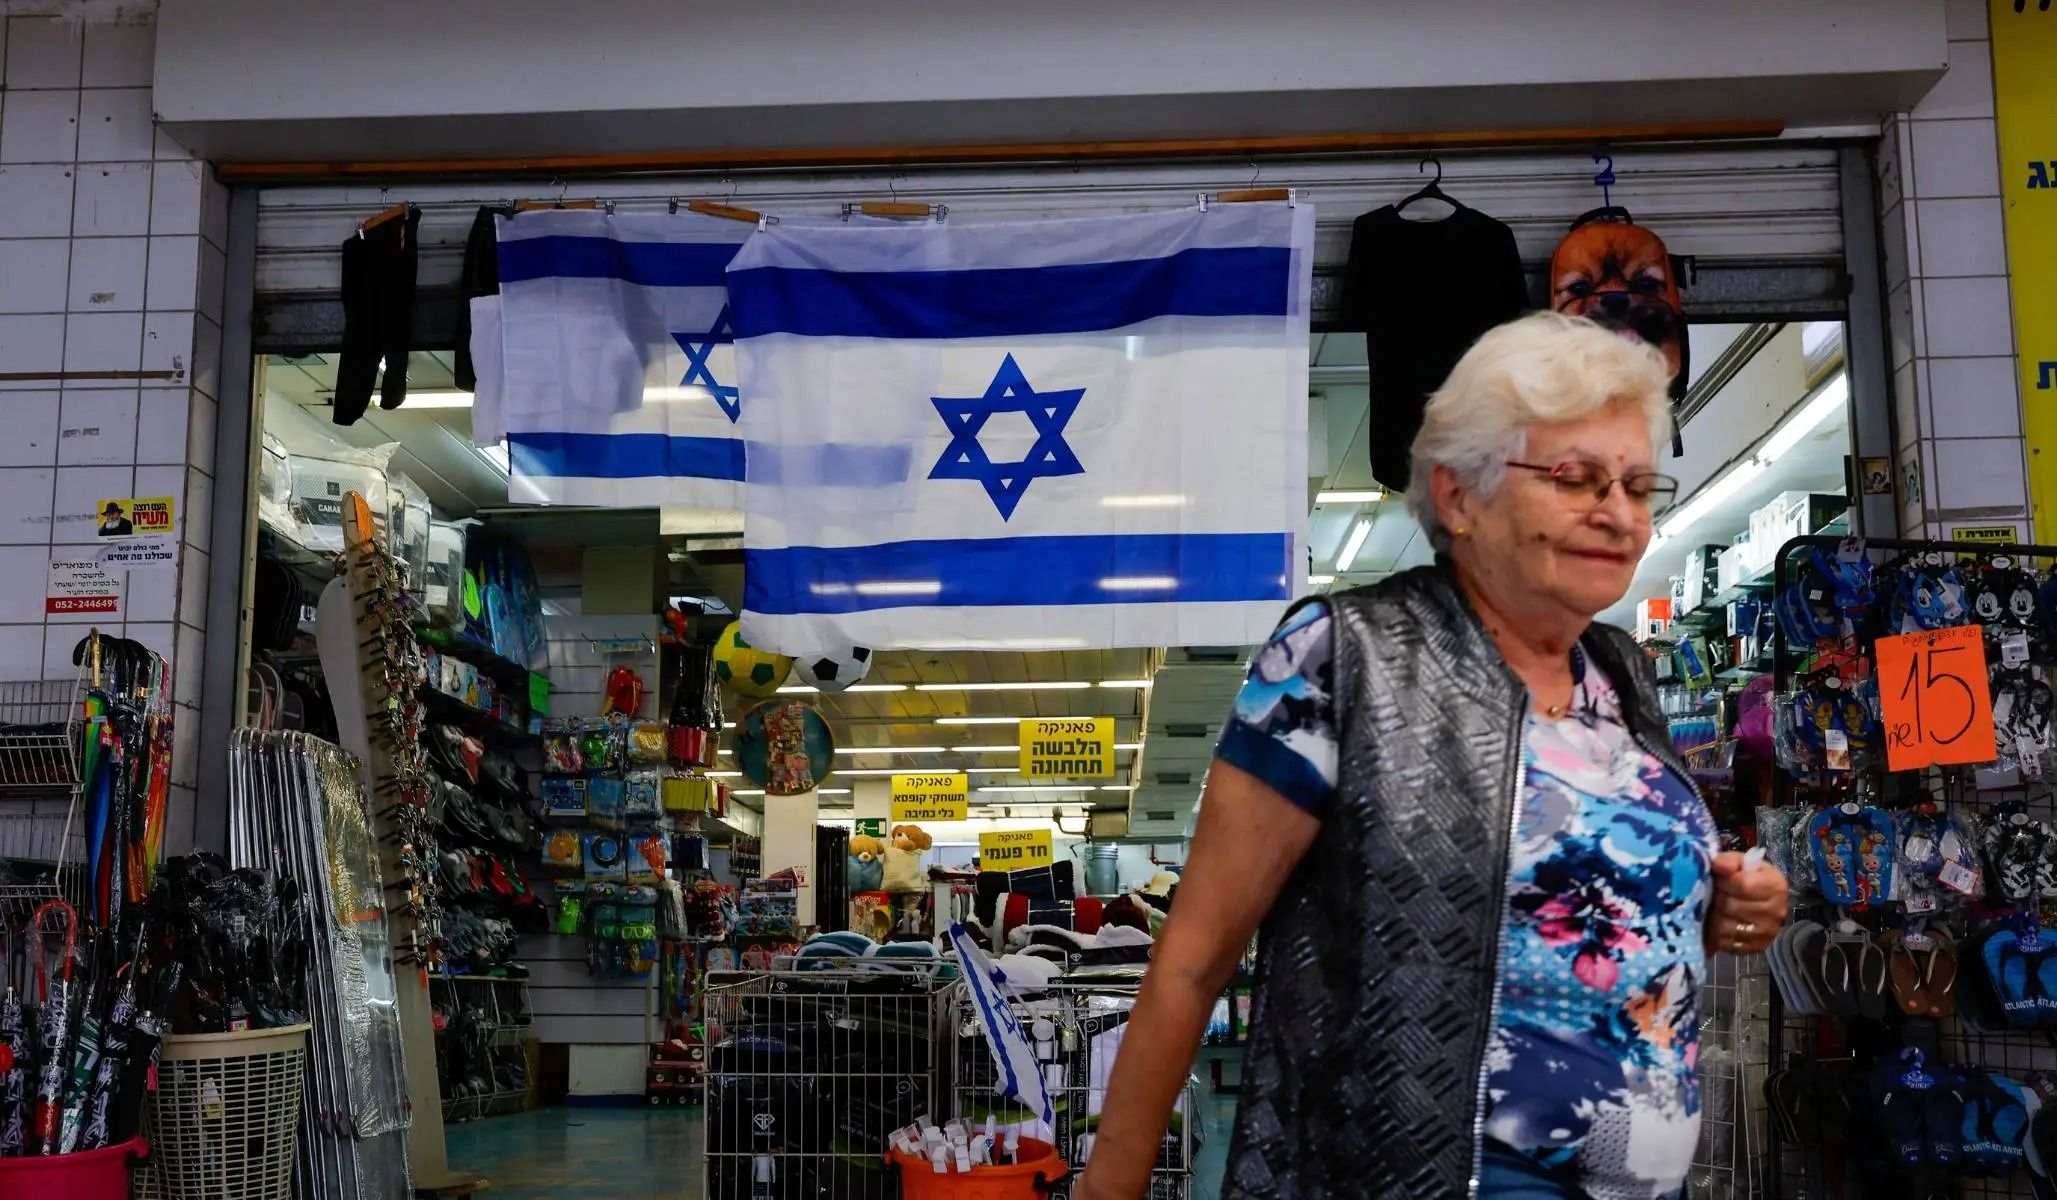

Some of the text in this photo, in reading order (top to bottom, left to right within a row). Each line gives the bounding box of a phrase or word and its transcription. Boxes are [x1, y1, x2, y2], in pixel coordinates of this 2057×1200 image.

[132, 511, 169, 525] משיח
[1900, 646, 1975, 745] 15
[1038, 722, 1096, 736] פאניקה
[1032, 737, 1102, 756] הלבשה
[1031, 759, 1102, 775] תחתונה
[906, 777, 952, 789] פאניקה
[894, 793, 965, 805] משחקי קופסא
[904, 808, 954, 818] כלי כתיבה
[997, 833, 1033, 843] פאניקה
[984, 845, 1048, 860] חד פעמי
